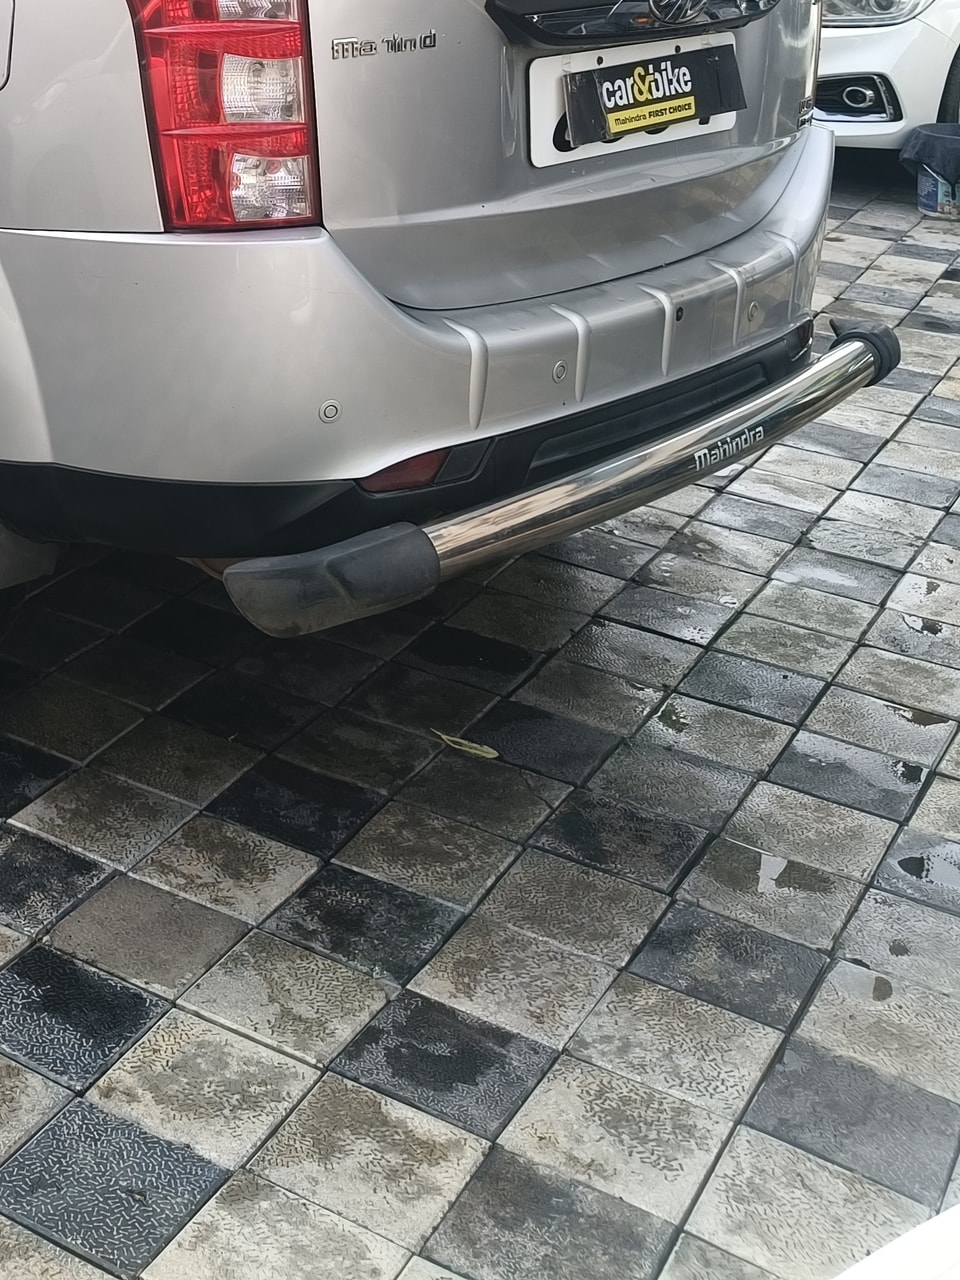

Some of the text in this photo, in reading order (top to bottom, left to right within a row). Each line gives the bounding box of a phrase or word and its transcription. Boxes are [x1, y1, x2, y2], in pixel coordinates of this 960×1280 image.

[602, 61, 691, 108] car&bike
[615, 103, 692, 126] Mahindra FIRST CHOICE
[694, 426, 764, 470] Mahindra
